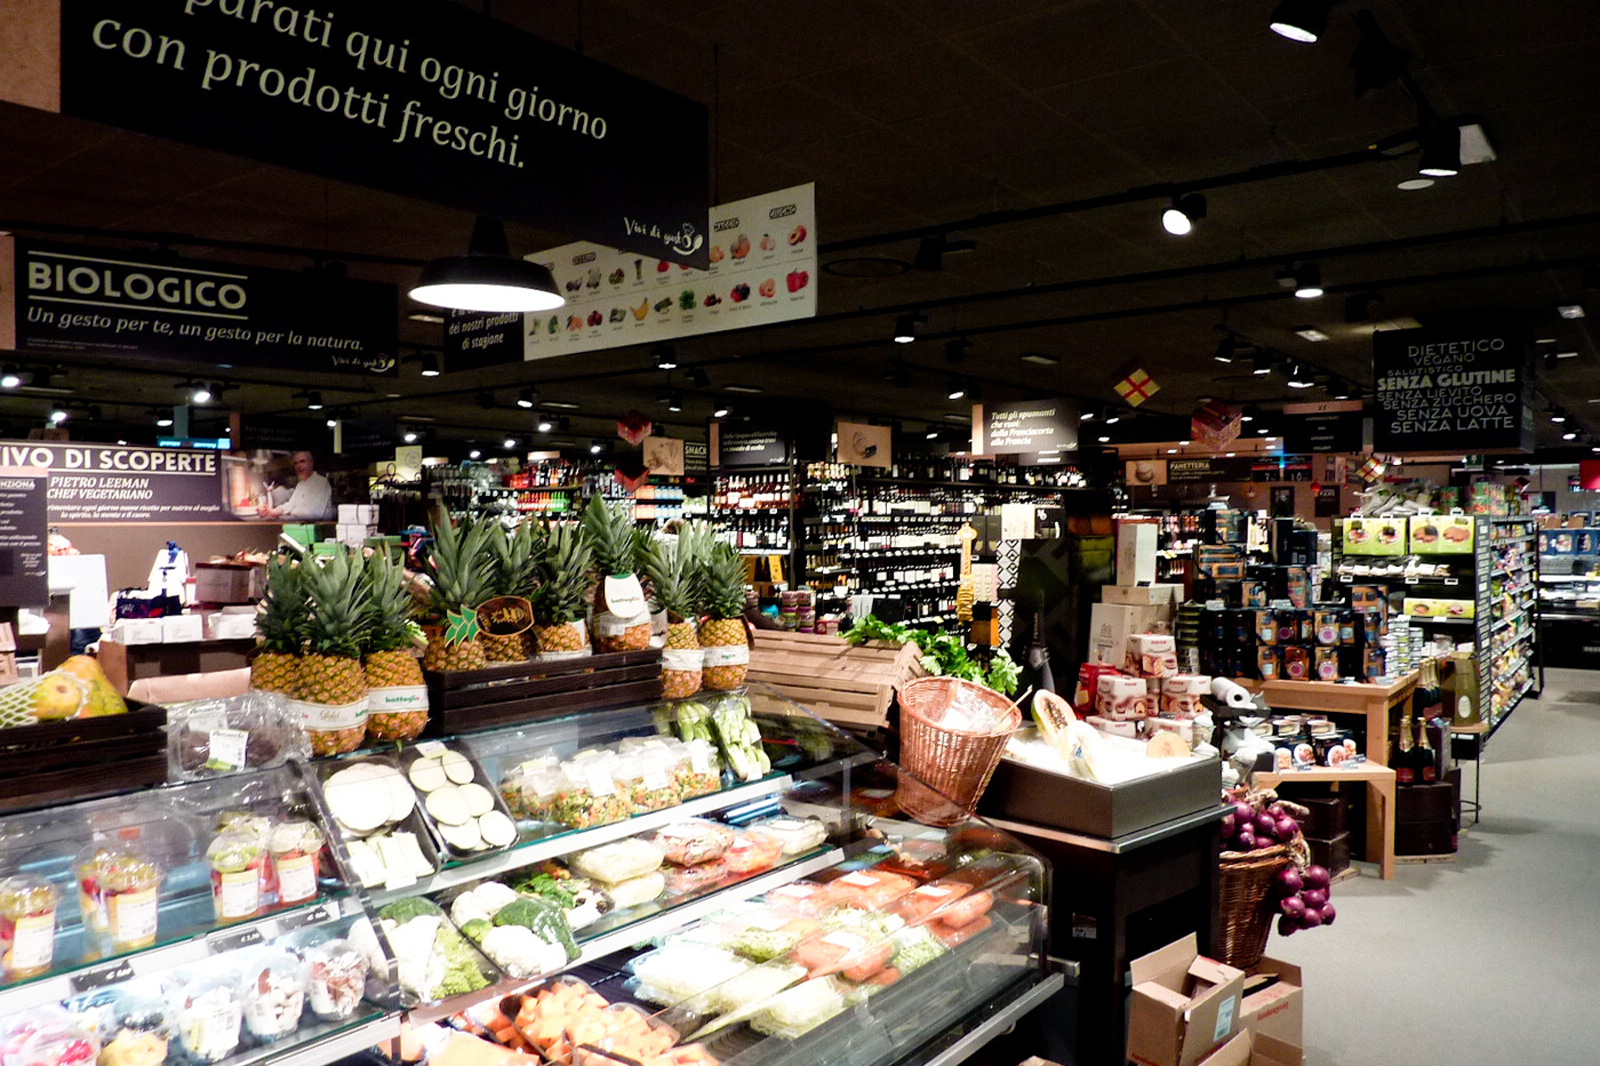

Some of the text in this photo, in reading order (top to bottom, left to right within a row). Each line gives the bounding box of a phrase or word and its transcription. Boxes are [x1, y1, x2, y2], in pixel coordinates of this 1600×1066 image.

[92, 19, 524, 168] con prodotti freschi.
[346, 31, 410, 73] qui
[420, 57, 499, 103] ogni
[504, 87, 607, 139] giorno
[649, 223, 661, 239] di
[28, 262, 247, 310] BIOLOGICO
[27, 307, 364, 351] Un gesto per te, un gesto per la natura.
[461, 316, 485, 333] nostri
[485, 312, 519, 331] prodotti
[461, 332, 505, 351] di stagione
[1408, 338, 1505, 357] DIETETICO
[1413, 352, 1475, 366] VEGANO
[1377, 368, 1516, 391] SENZA GLUTINE
[1387, 365, 1463, 376] SALUTISTICO
[1377, 386, 1483, 401] SENZA LIEVITO
[1383, 392, 1517, 410] SENZA ZUCCHERO
[1397, 405, 1508, 421] SENZA UOVA
[1390, 416, 1515, 434] SENZA LATTE
[0, 446, 216, 472] IVO DI SCOPERTE
[50, 476, 149, 488] PIETRO LEEMAN
[47, 489, 153, 499] CHEF VEGETARIANO
